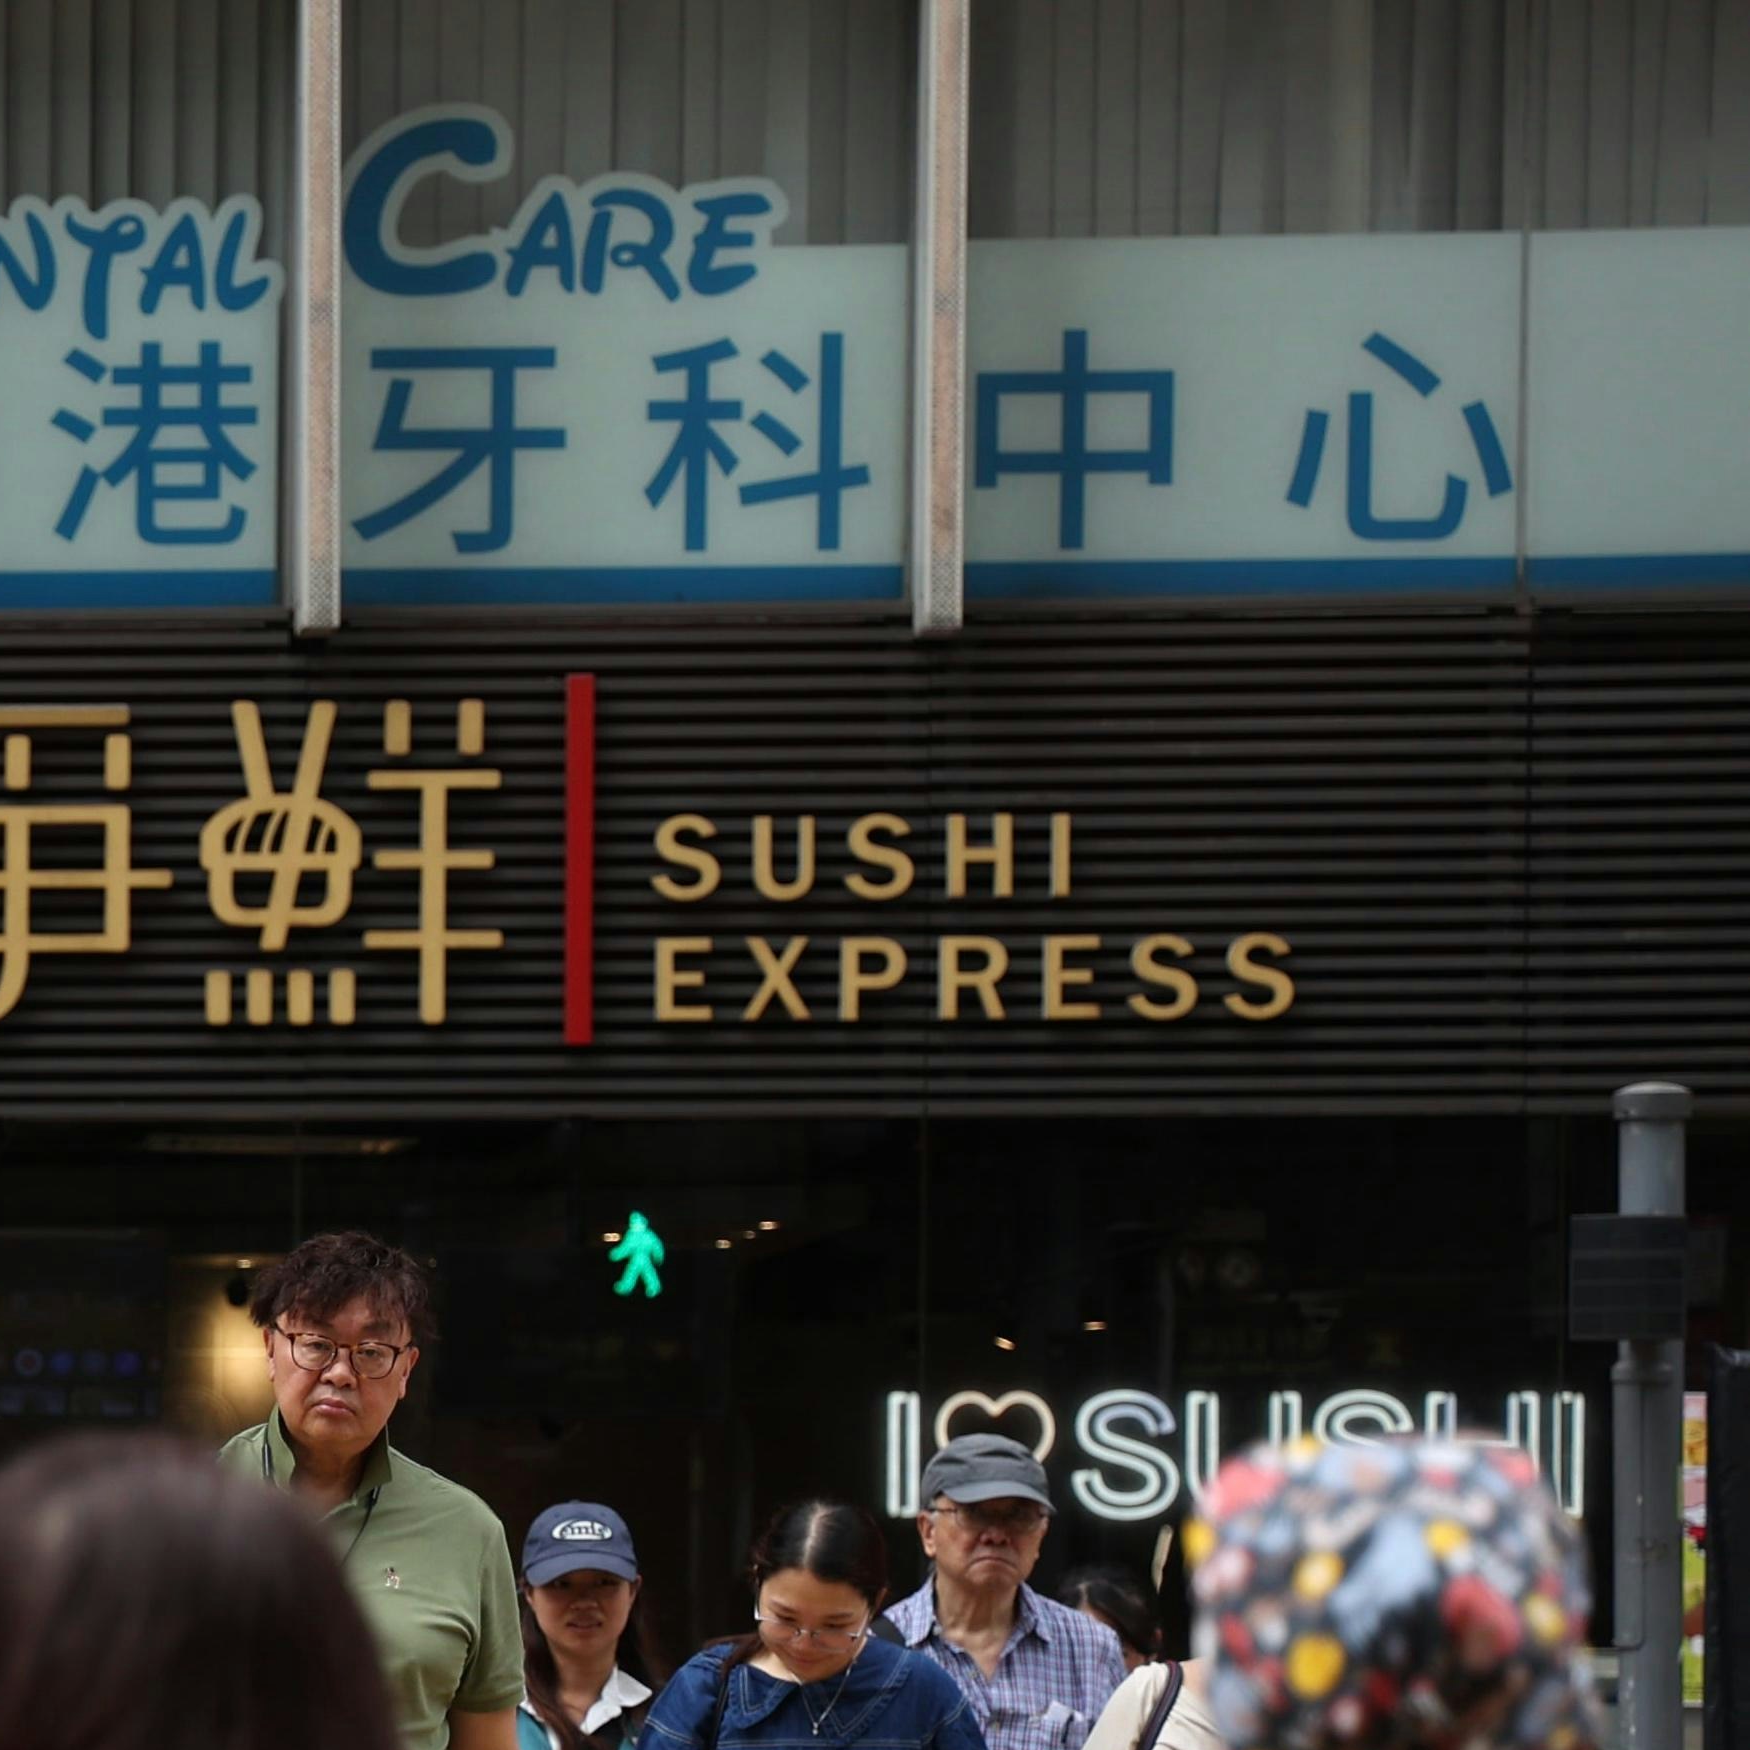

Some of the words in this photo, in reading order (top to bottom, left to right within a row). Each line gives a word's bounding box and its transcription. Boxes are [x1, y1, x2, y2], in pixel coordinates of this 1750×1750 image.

[651, 812, 1073, 901] SUSHI
[654, 932, 1298, 1021] EXPRESS
[885, 1389, 922, 1520] I
